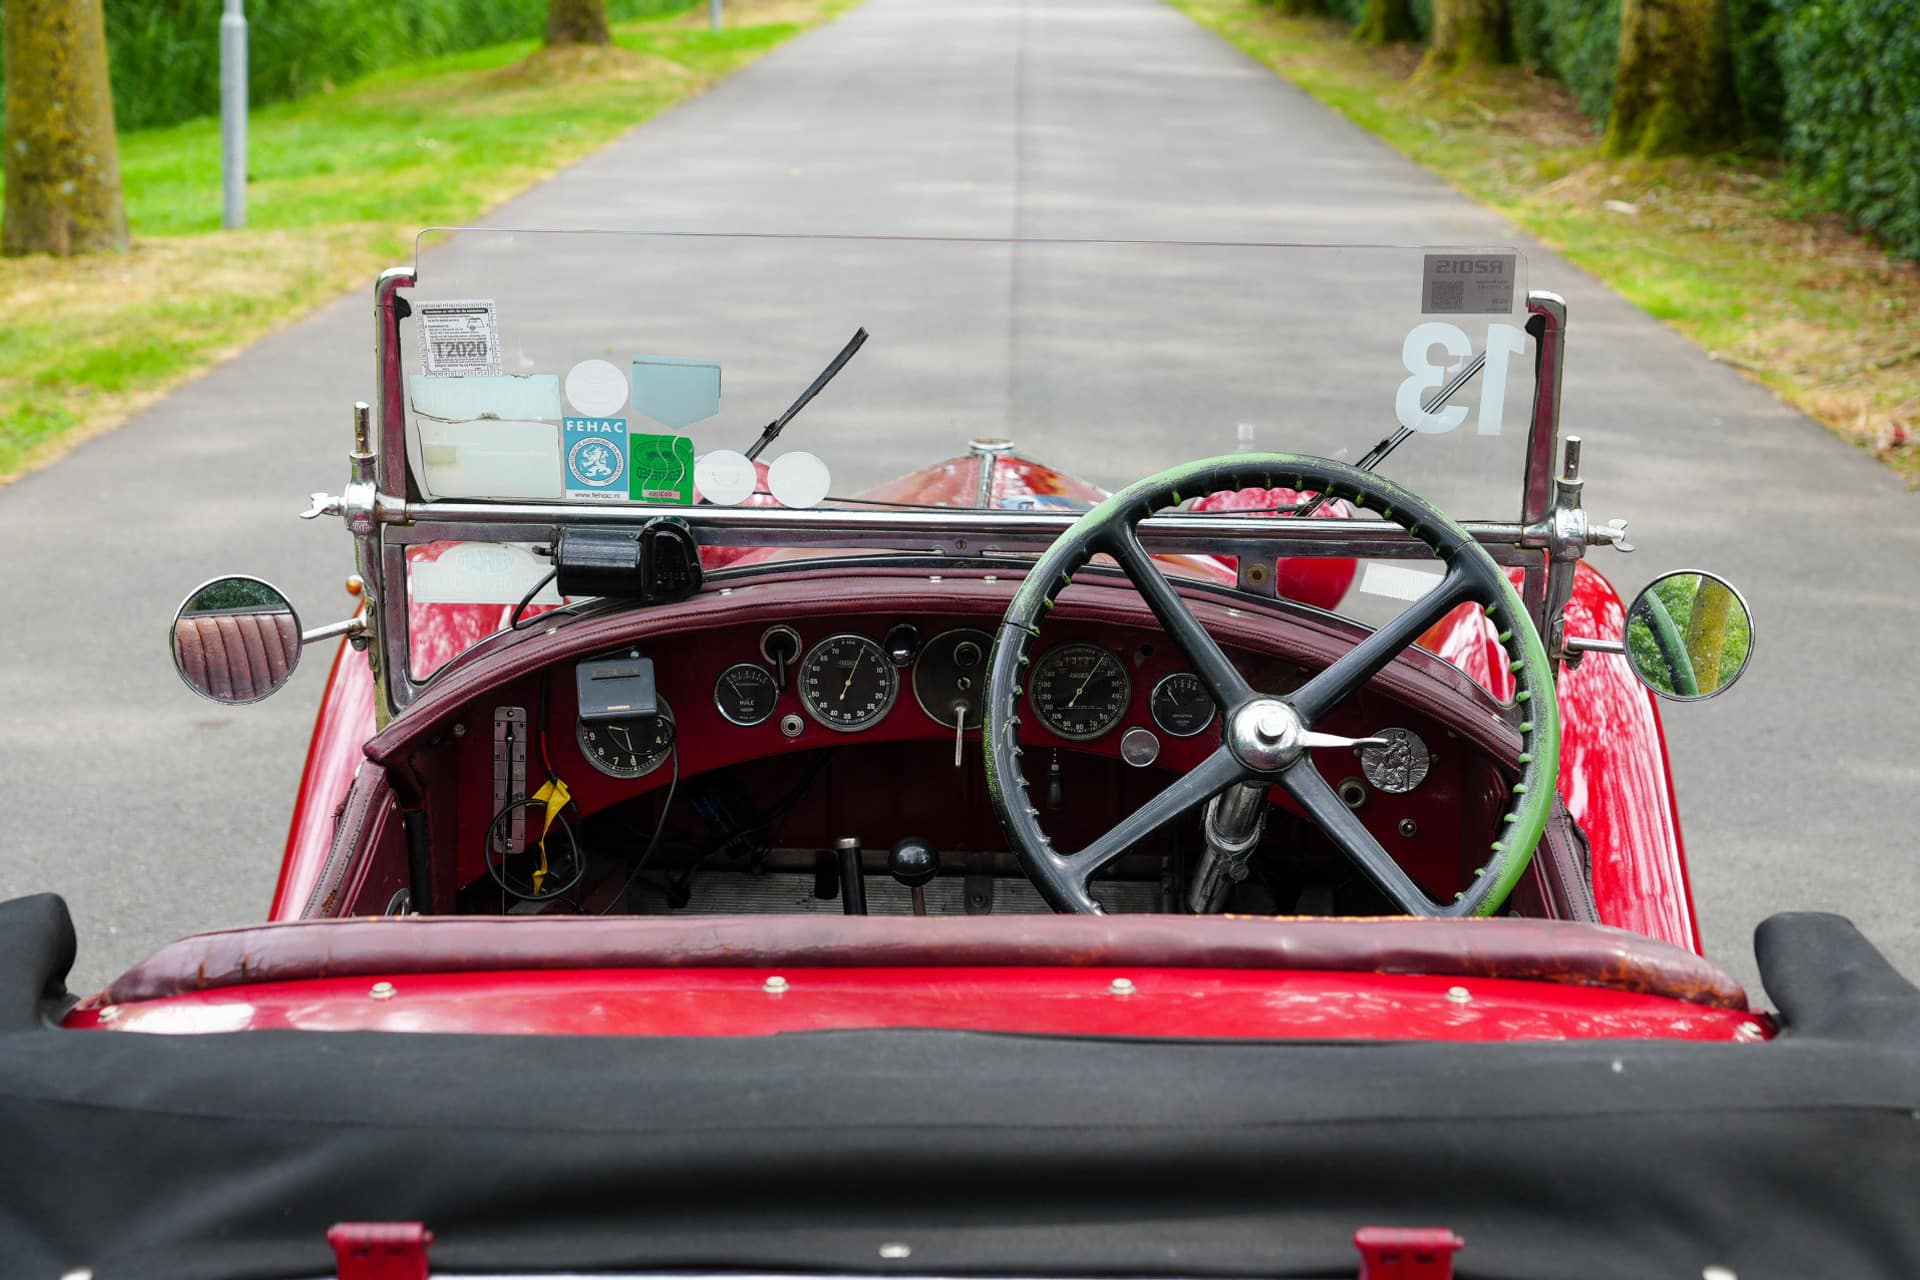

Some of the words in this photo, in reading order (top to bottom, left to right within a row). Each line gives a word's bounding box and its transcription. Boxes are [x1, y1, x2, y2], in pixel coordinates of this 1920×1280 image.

[566, 421, 623, 433] FEHAC
[657, 719, 663, 727] 3
[589, 732, 595, 740] 9
[656, 736, 662, 744] 4
[598, 747, 604, 755] 8
[613, 756, 619, 764] 7
